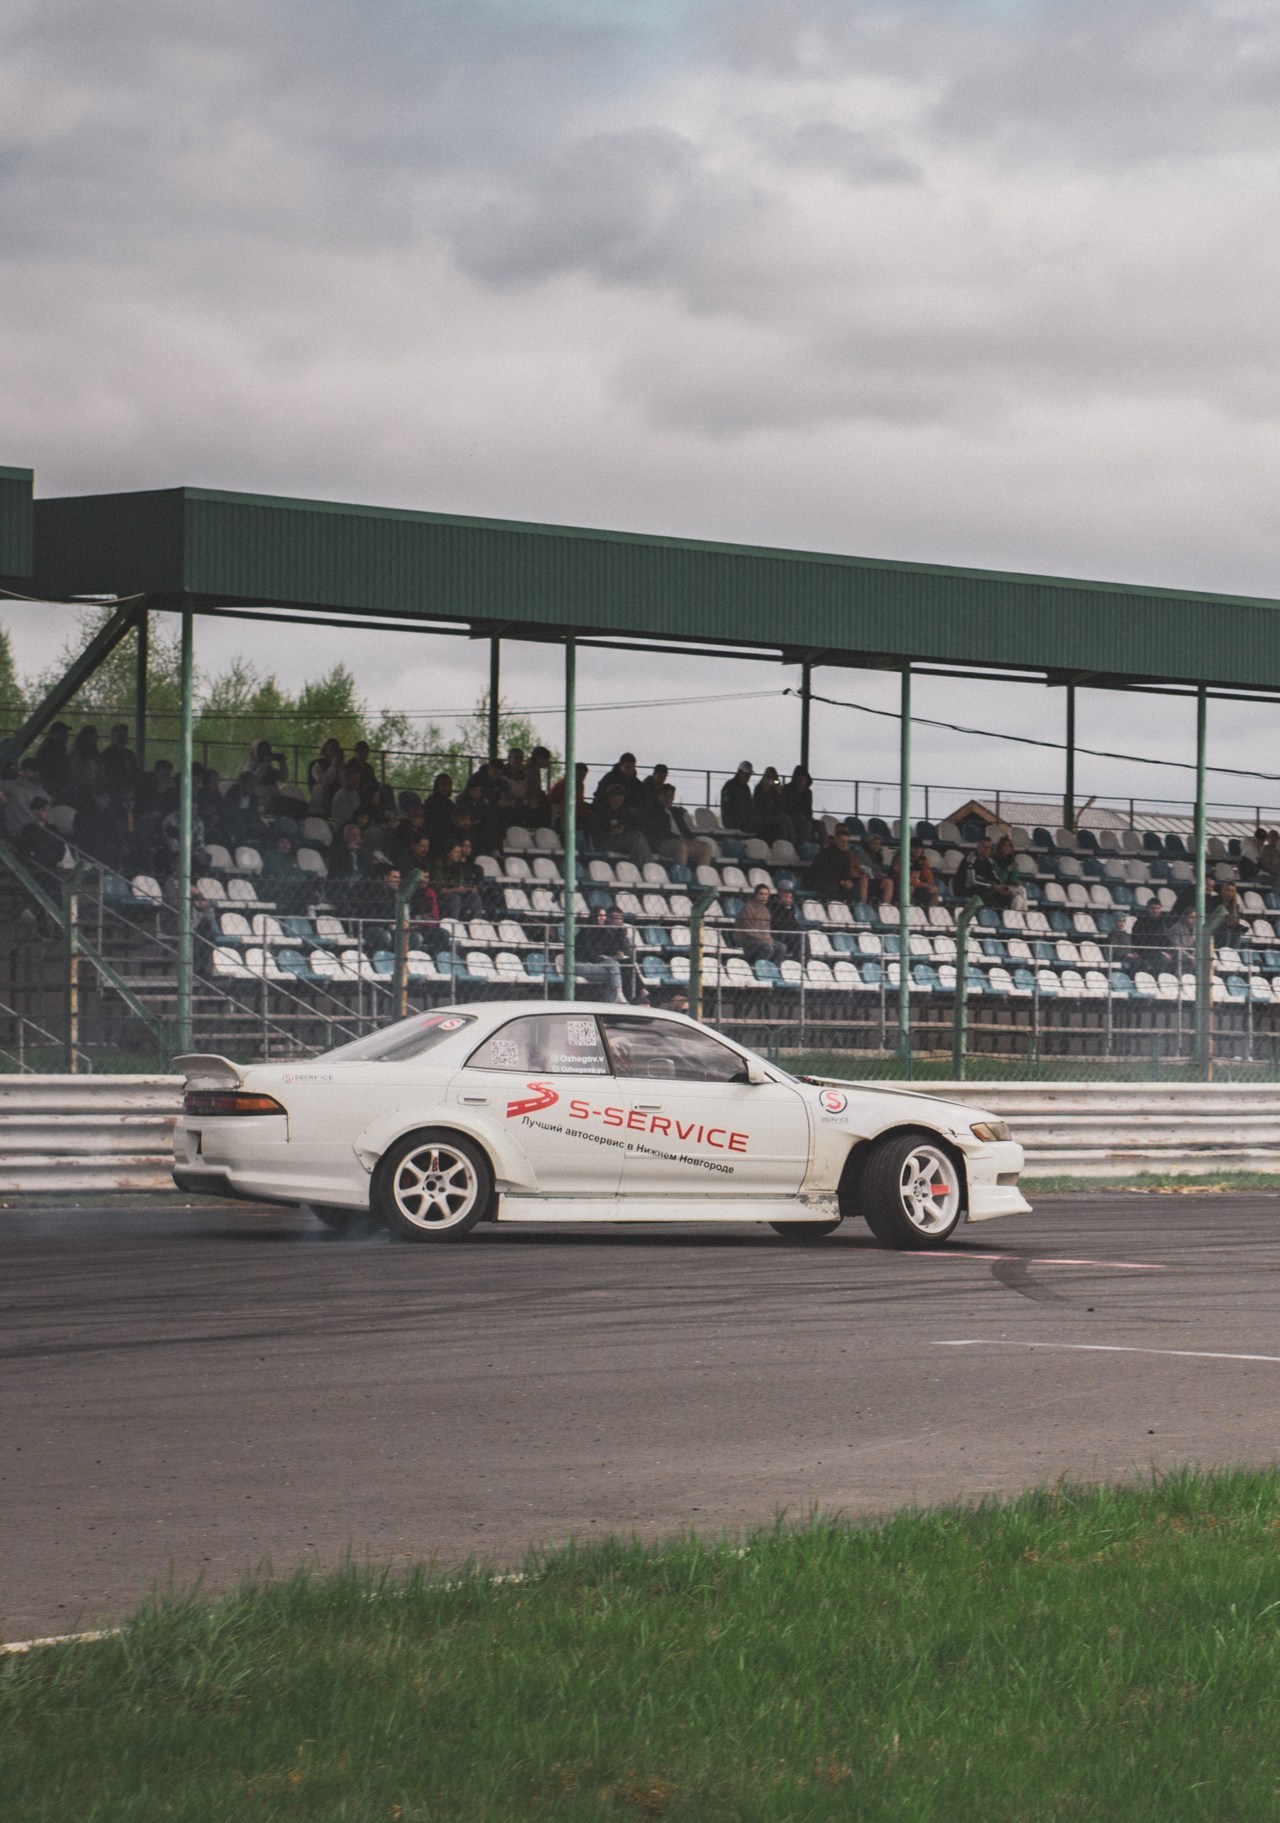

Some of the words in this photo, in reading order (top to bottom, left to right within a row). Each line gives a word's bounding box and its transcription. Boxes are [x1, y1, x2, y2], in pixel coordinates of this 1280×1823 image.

[559, 1055, 605, 1064] Ozhegov.v
[521, 1115, 563, 1134] Лучший
[565, 1128, 625, 1150] автосервис
[626, 1143, 634, 1152] в
[636, 1143, 677, 1162] Нижнем
[679, 1154, 735, 1174] Новгороде
[568, 1099, 750, 1153] S-SERVICE
